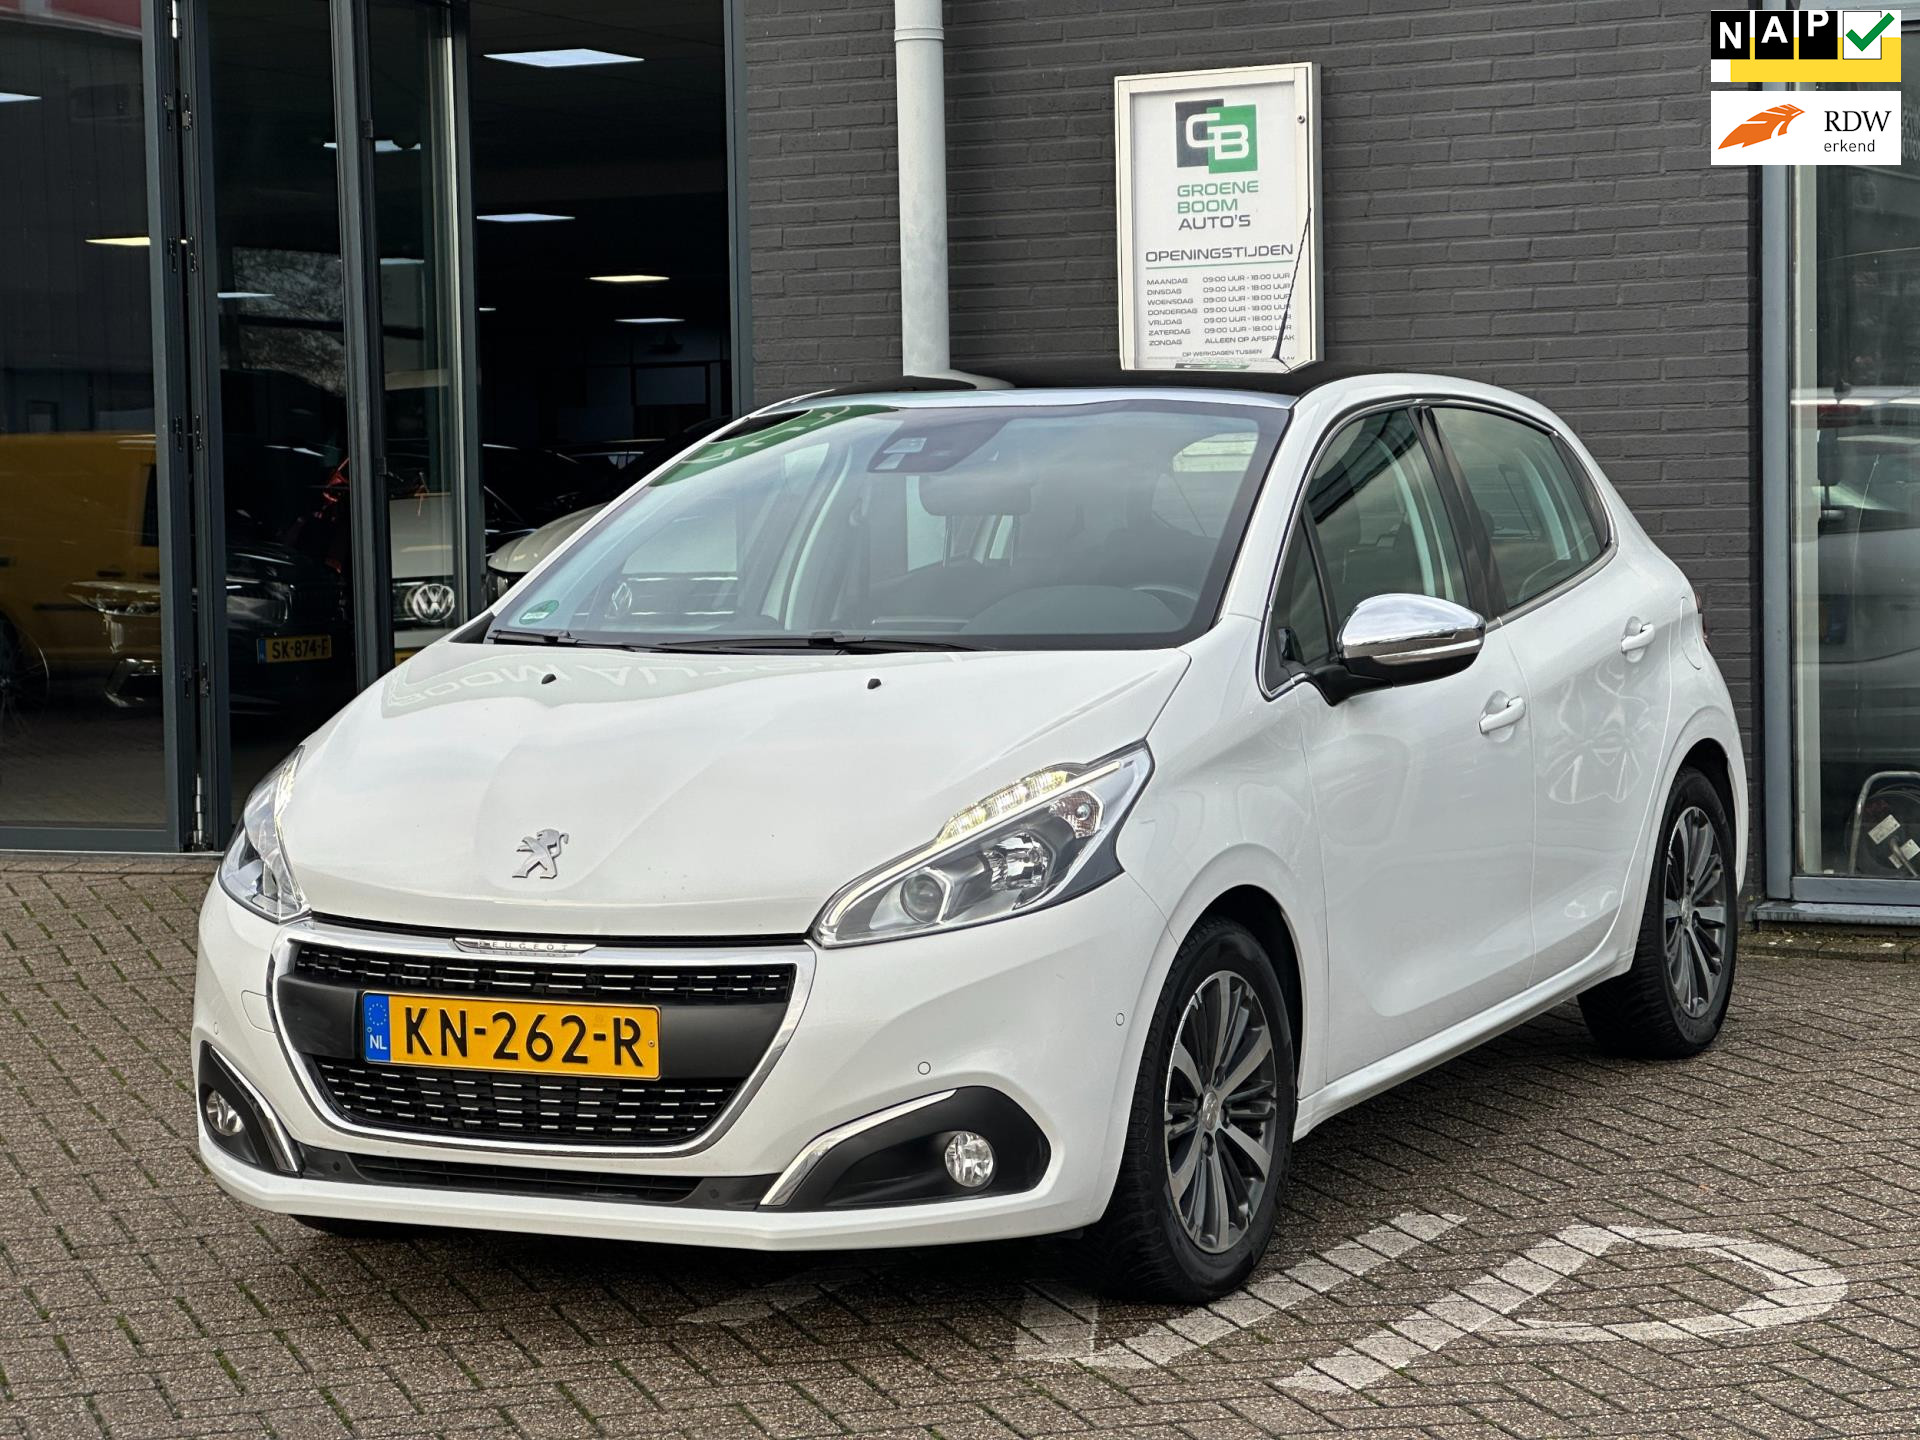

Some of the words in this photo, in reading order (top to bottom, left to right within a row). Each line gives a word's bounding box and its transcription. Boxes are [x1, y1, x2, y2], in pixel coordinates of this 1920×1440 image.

[1177, 180, 1259, 198] GROENE
[1177, 199, 1238, 214] BOOM
[1178, 214, 1251, 231] AUTO'S
[1145, 243, 1293, 262] OPENINGSTIJDEN
[1146, 277, 1188, 285] MAANDAG
[1146, 288, 1182, 296] DINSDAG
[1147, 298, 1194, 306] WOENSDAG
[1147, 308, 1198, 316] DONDERDAG
[1148, 318, 1183, 326] VRIJDAG
[1148, 328, 1191, 336] ZATERDAG
[1251, 334, 1295, 342] AFSPRAK
[272, 638, 329, 659] SK-874-F
[369, 1034, 387, 1050] NL
[404, 1006, 644, 1068] KN-262-R
